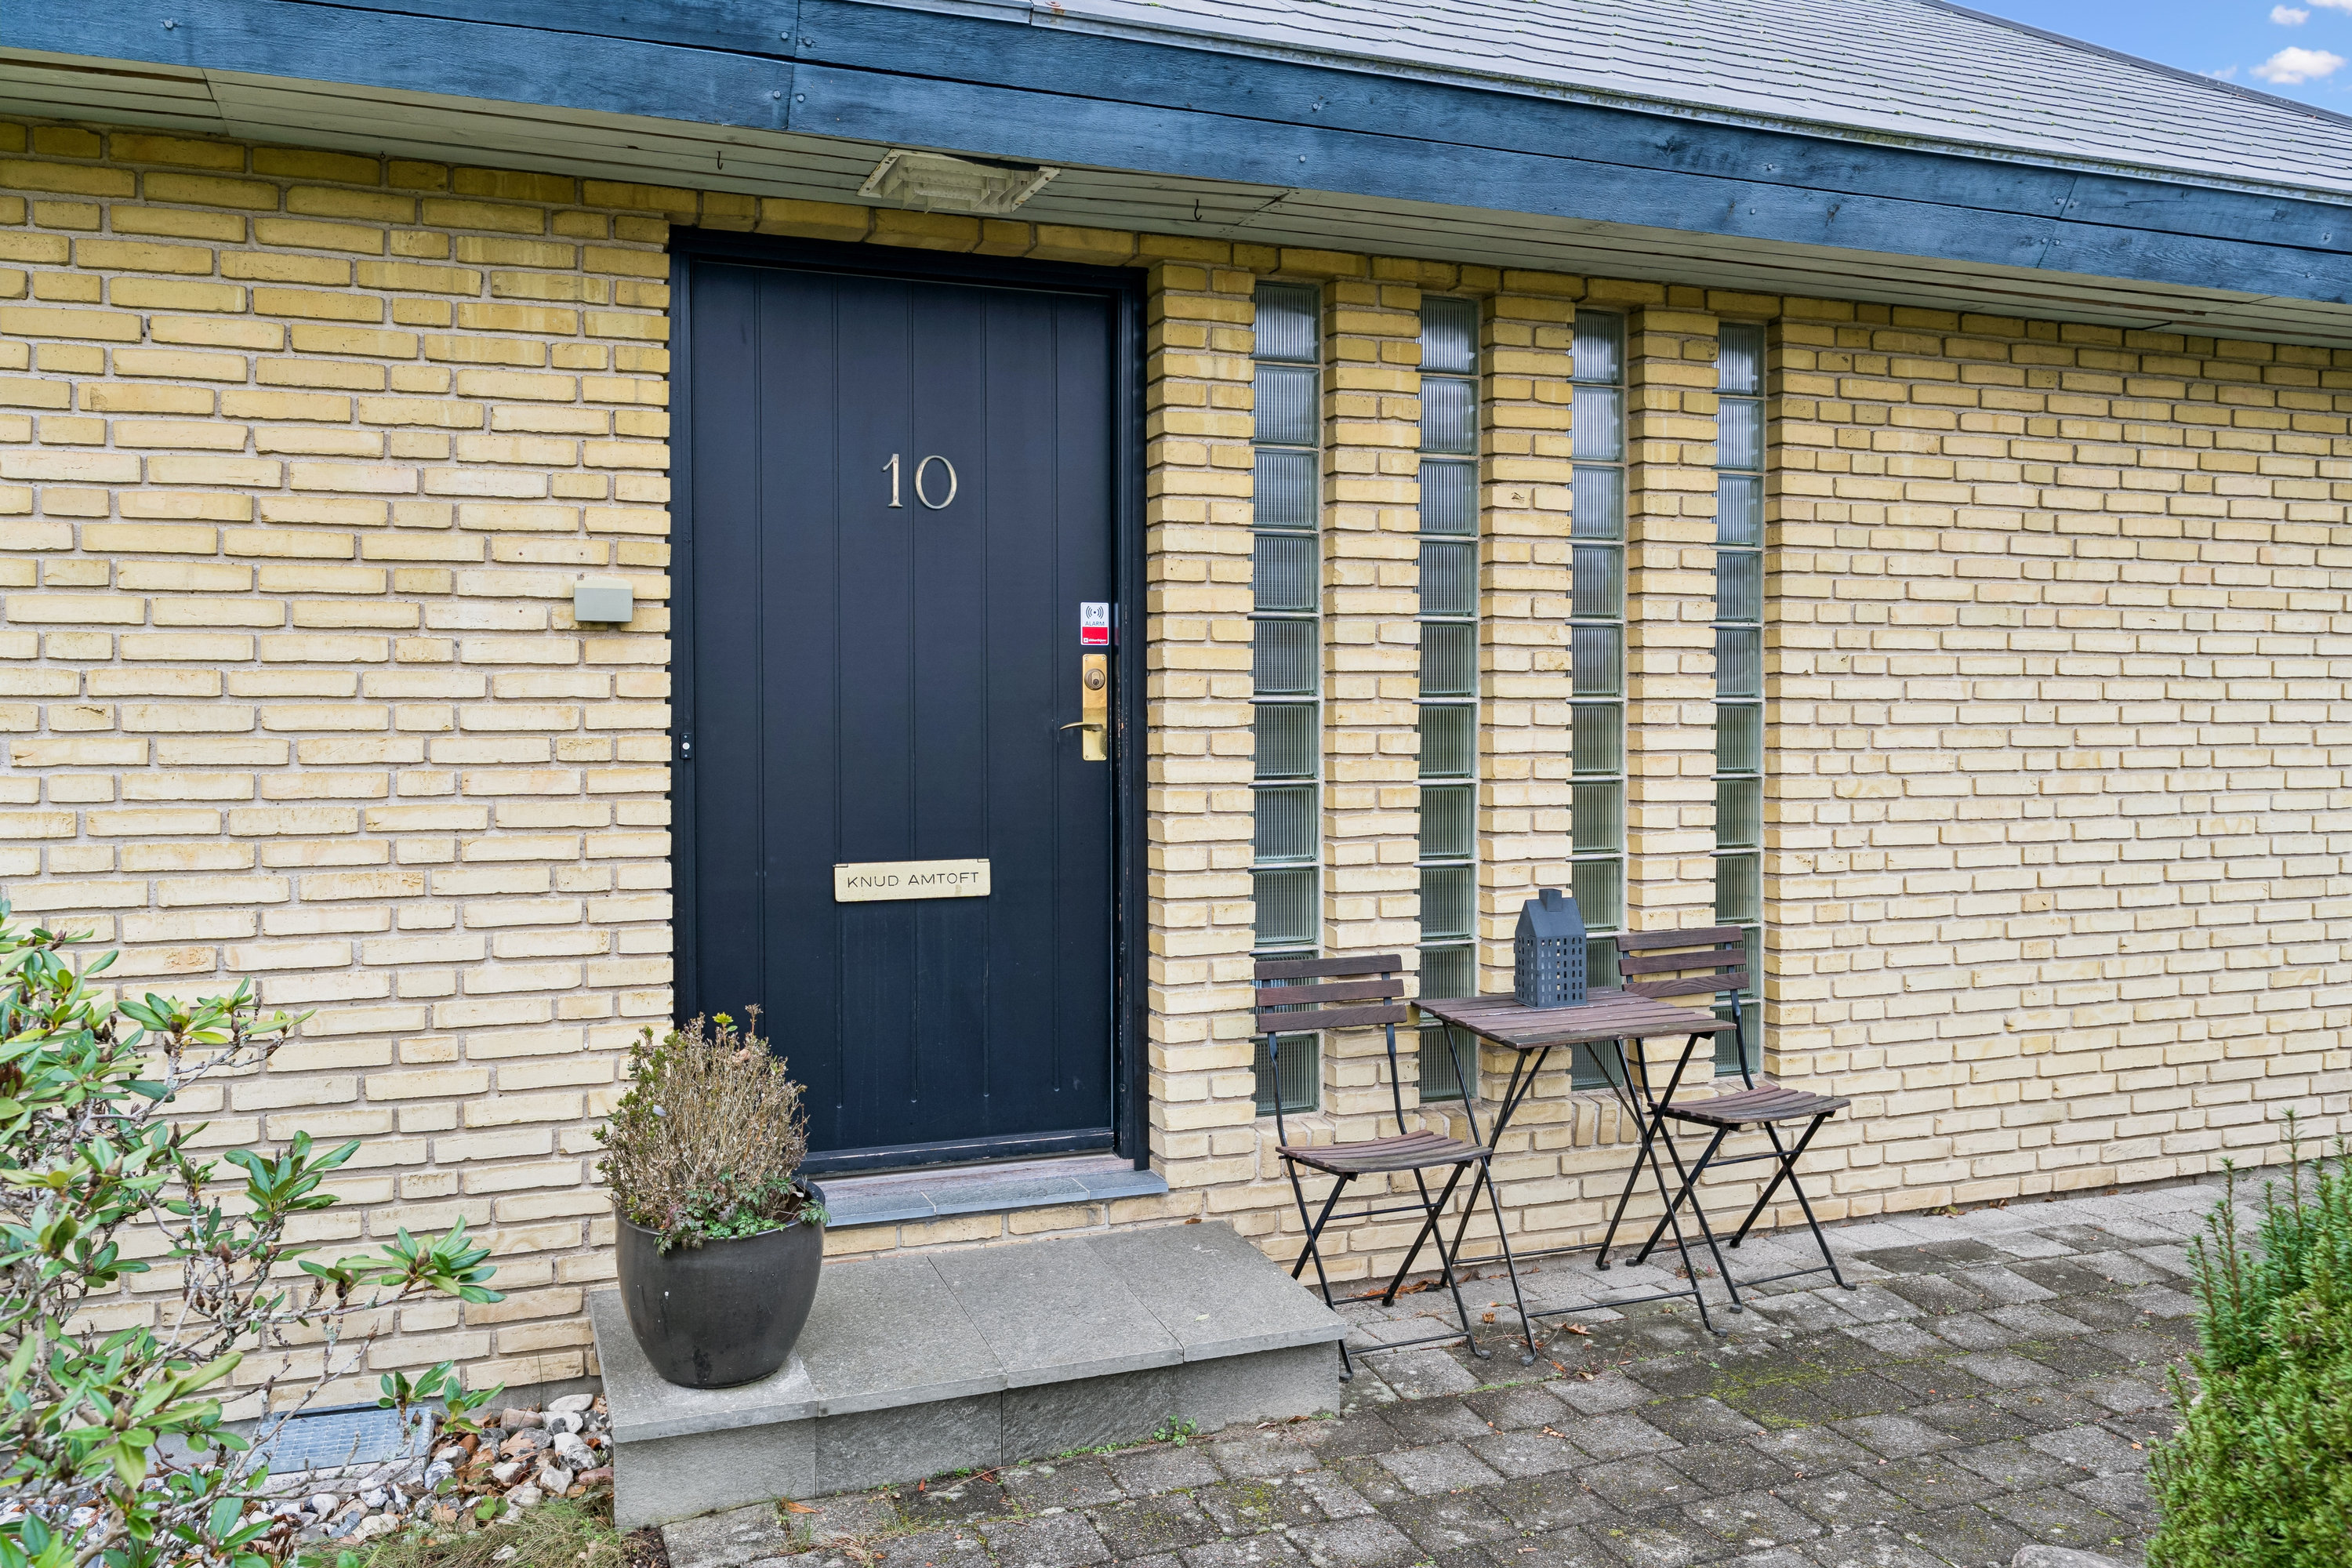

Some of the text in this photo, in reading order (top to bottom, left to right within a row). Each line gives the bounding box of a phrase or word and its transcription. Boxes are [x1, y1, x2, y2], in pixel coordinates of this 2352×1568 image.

[882, 453, 957, 510] 10
[848, 872, 979, 888] KNUD AMTOFT
